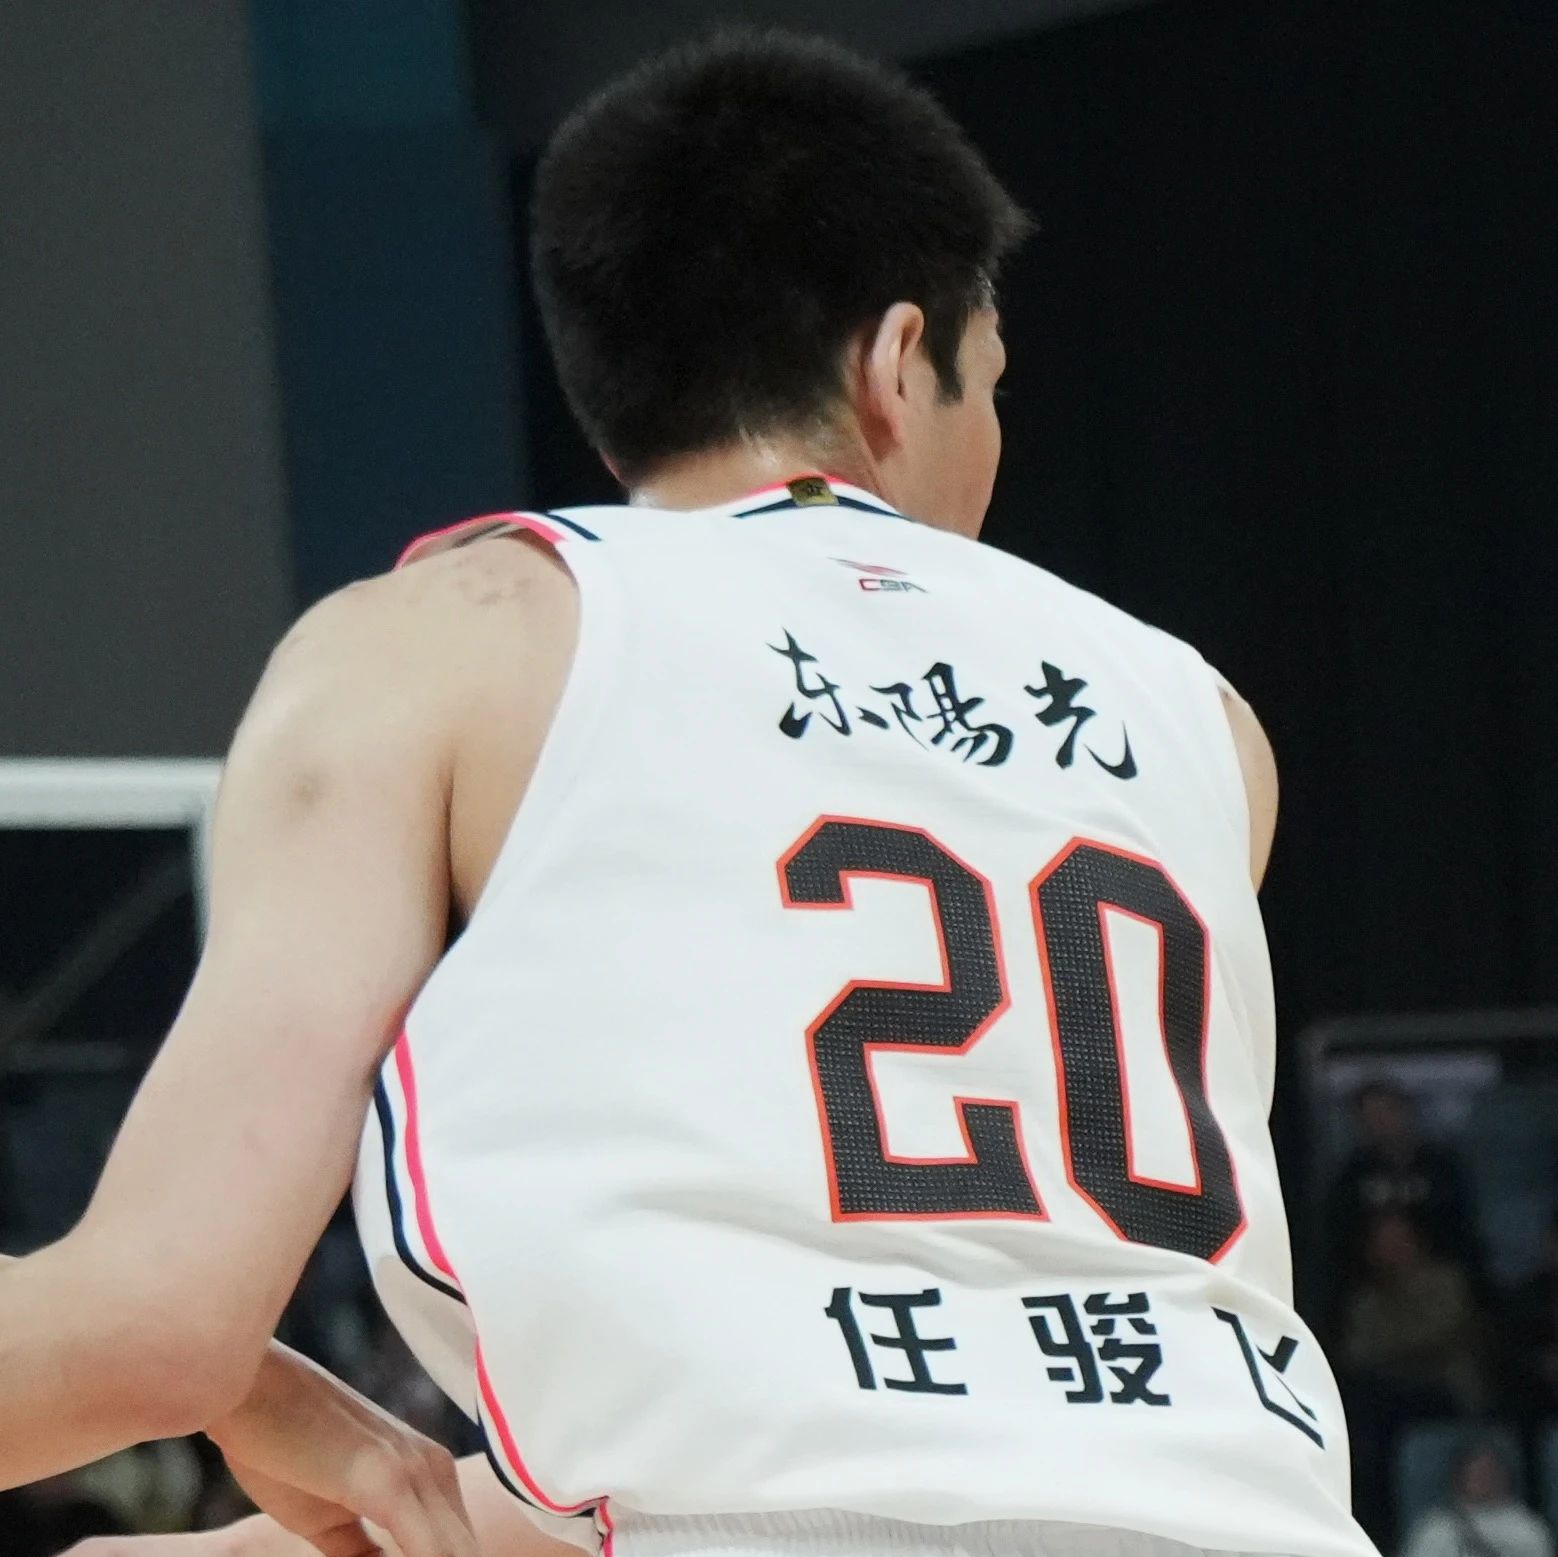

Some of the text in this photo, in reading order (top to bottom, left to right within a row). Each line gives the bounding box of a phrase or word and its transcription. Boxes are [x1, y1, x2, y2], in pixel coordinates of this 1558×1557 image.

[858, 577, 928, 594] CBA
[775, 812, 1248, 1265] 20
[822, 1285, 1326, 1451] 任骏飞
